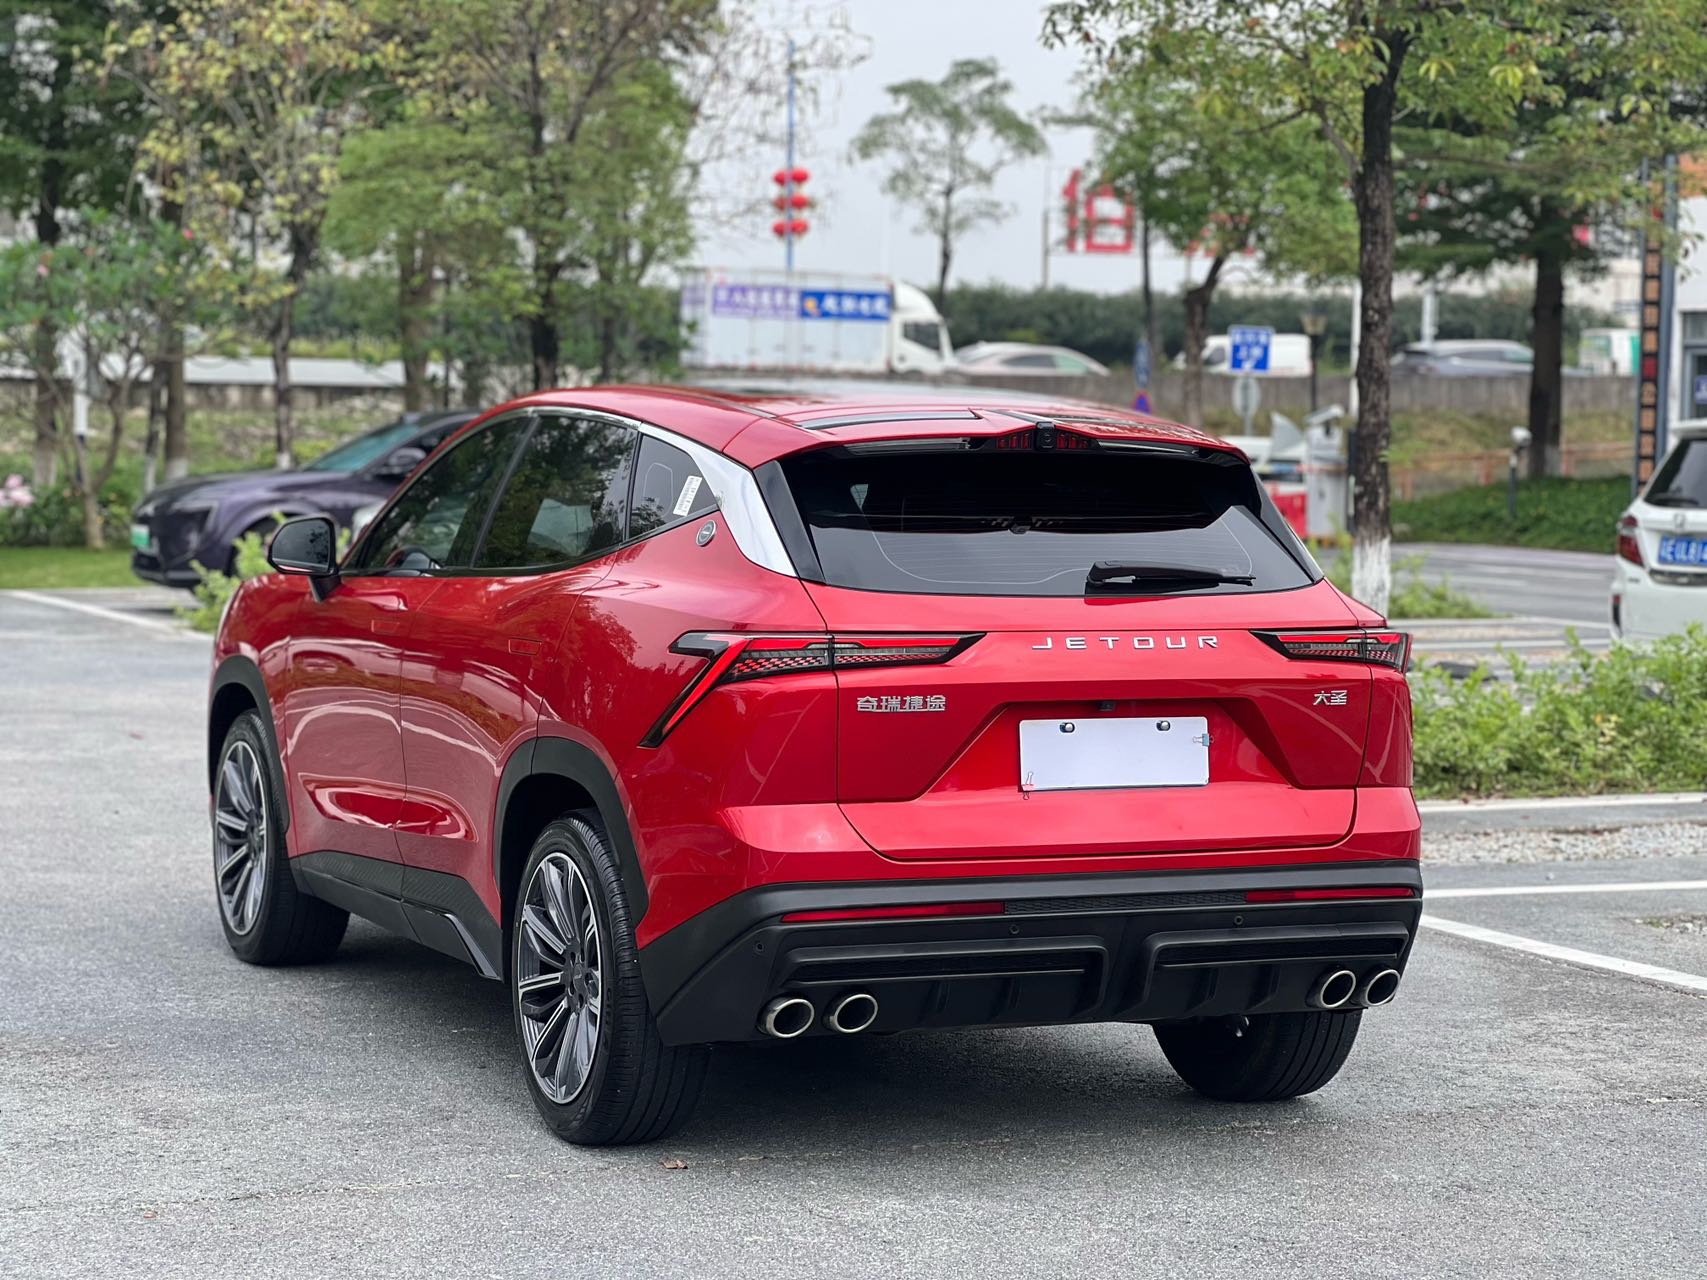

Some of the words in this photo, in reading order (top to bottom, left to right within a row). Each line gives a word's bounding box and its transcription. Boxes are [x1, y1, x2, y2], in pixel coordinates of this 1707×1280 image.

[1032, 636, 1219, 650] JETOUR
[857, 695, 946, 712] 奇瑞捷途
[1313, 690, 1347, 705] 大圣
